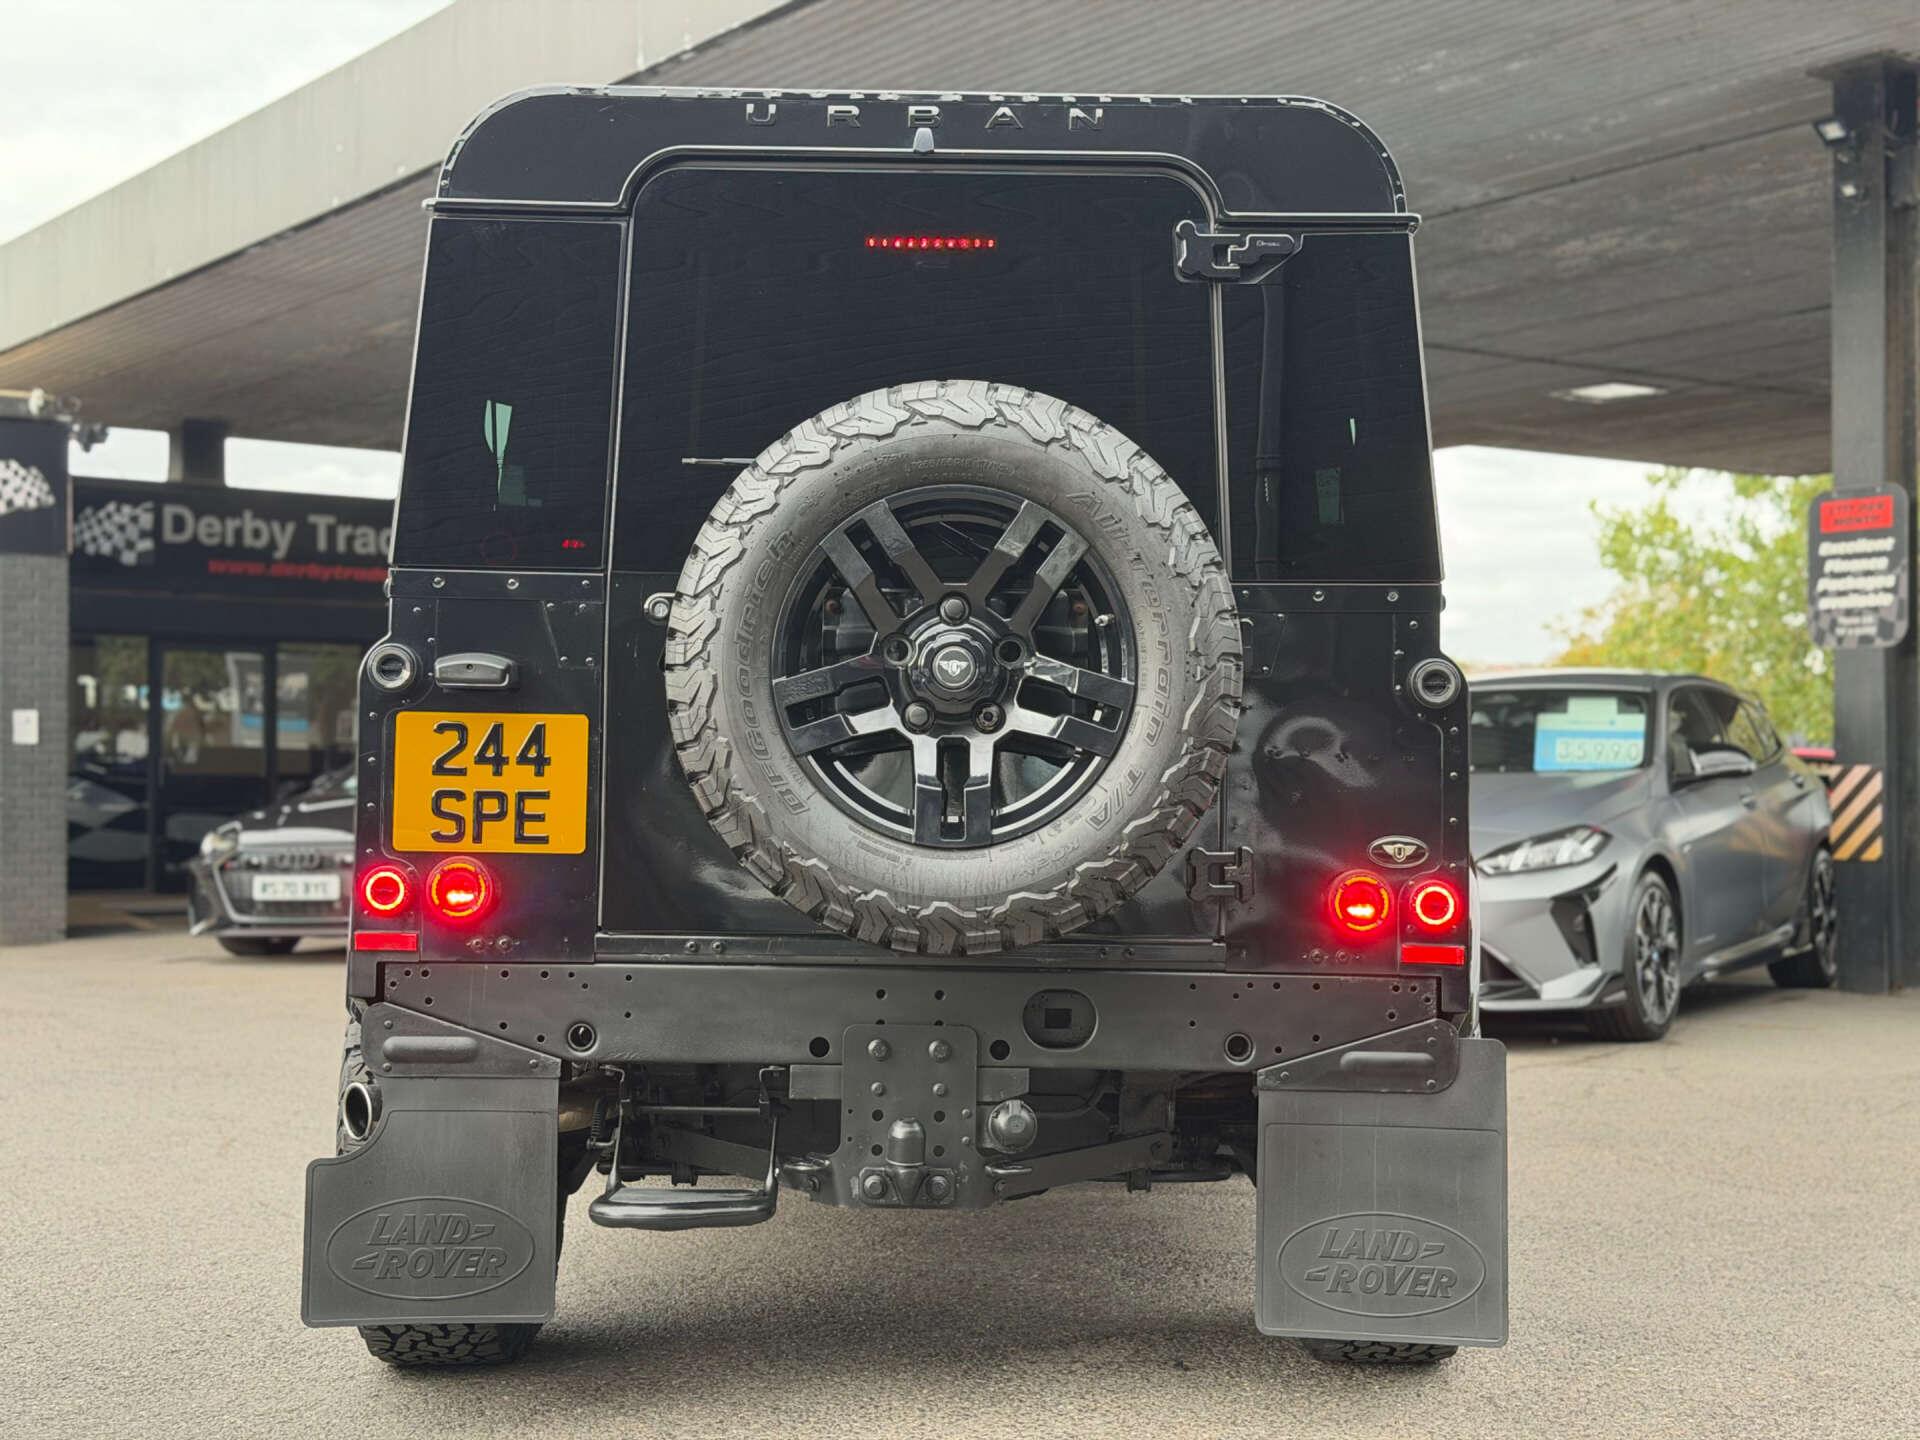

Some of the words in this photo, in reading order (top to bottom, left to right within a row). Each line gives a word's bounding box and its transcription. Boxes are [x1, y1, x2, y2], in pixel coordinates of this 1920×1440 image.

[745, 103, 1104, 130] URBAN
[161, 504, 296, 559] Derby
[431, 720, 552, 777] 244
[430, 787, 551, 844] SPE
[366, 1213, 471, 1246] LAND
[1318, 1227, 1420, 1262] LAND
[374, 1246, 508, 1280] ROVER
[1325, 1261, 1458, 1298] ROVER
